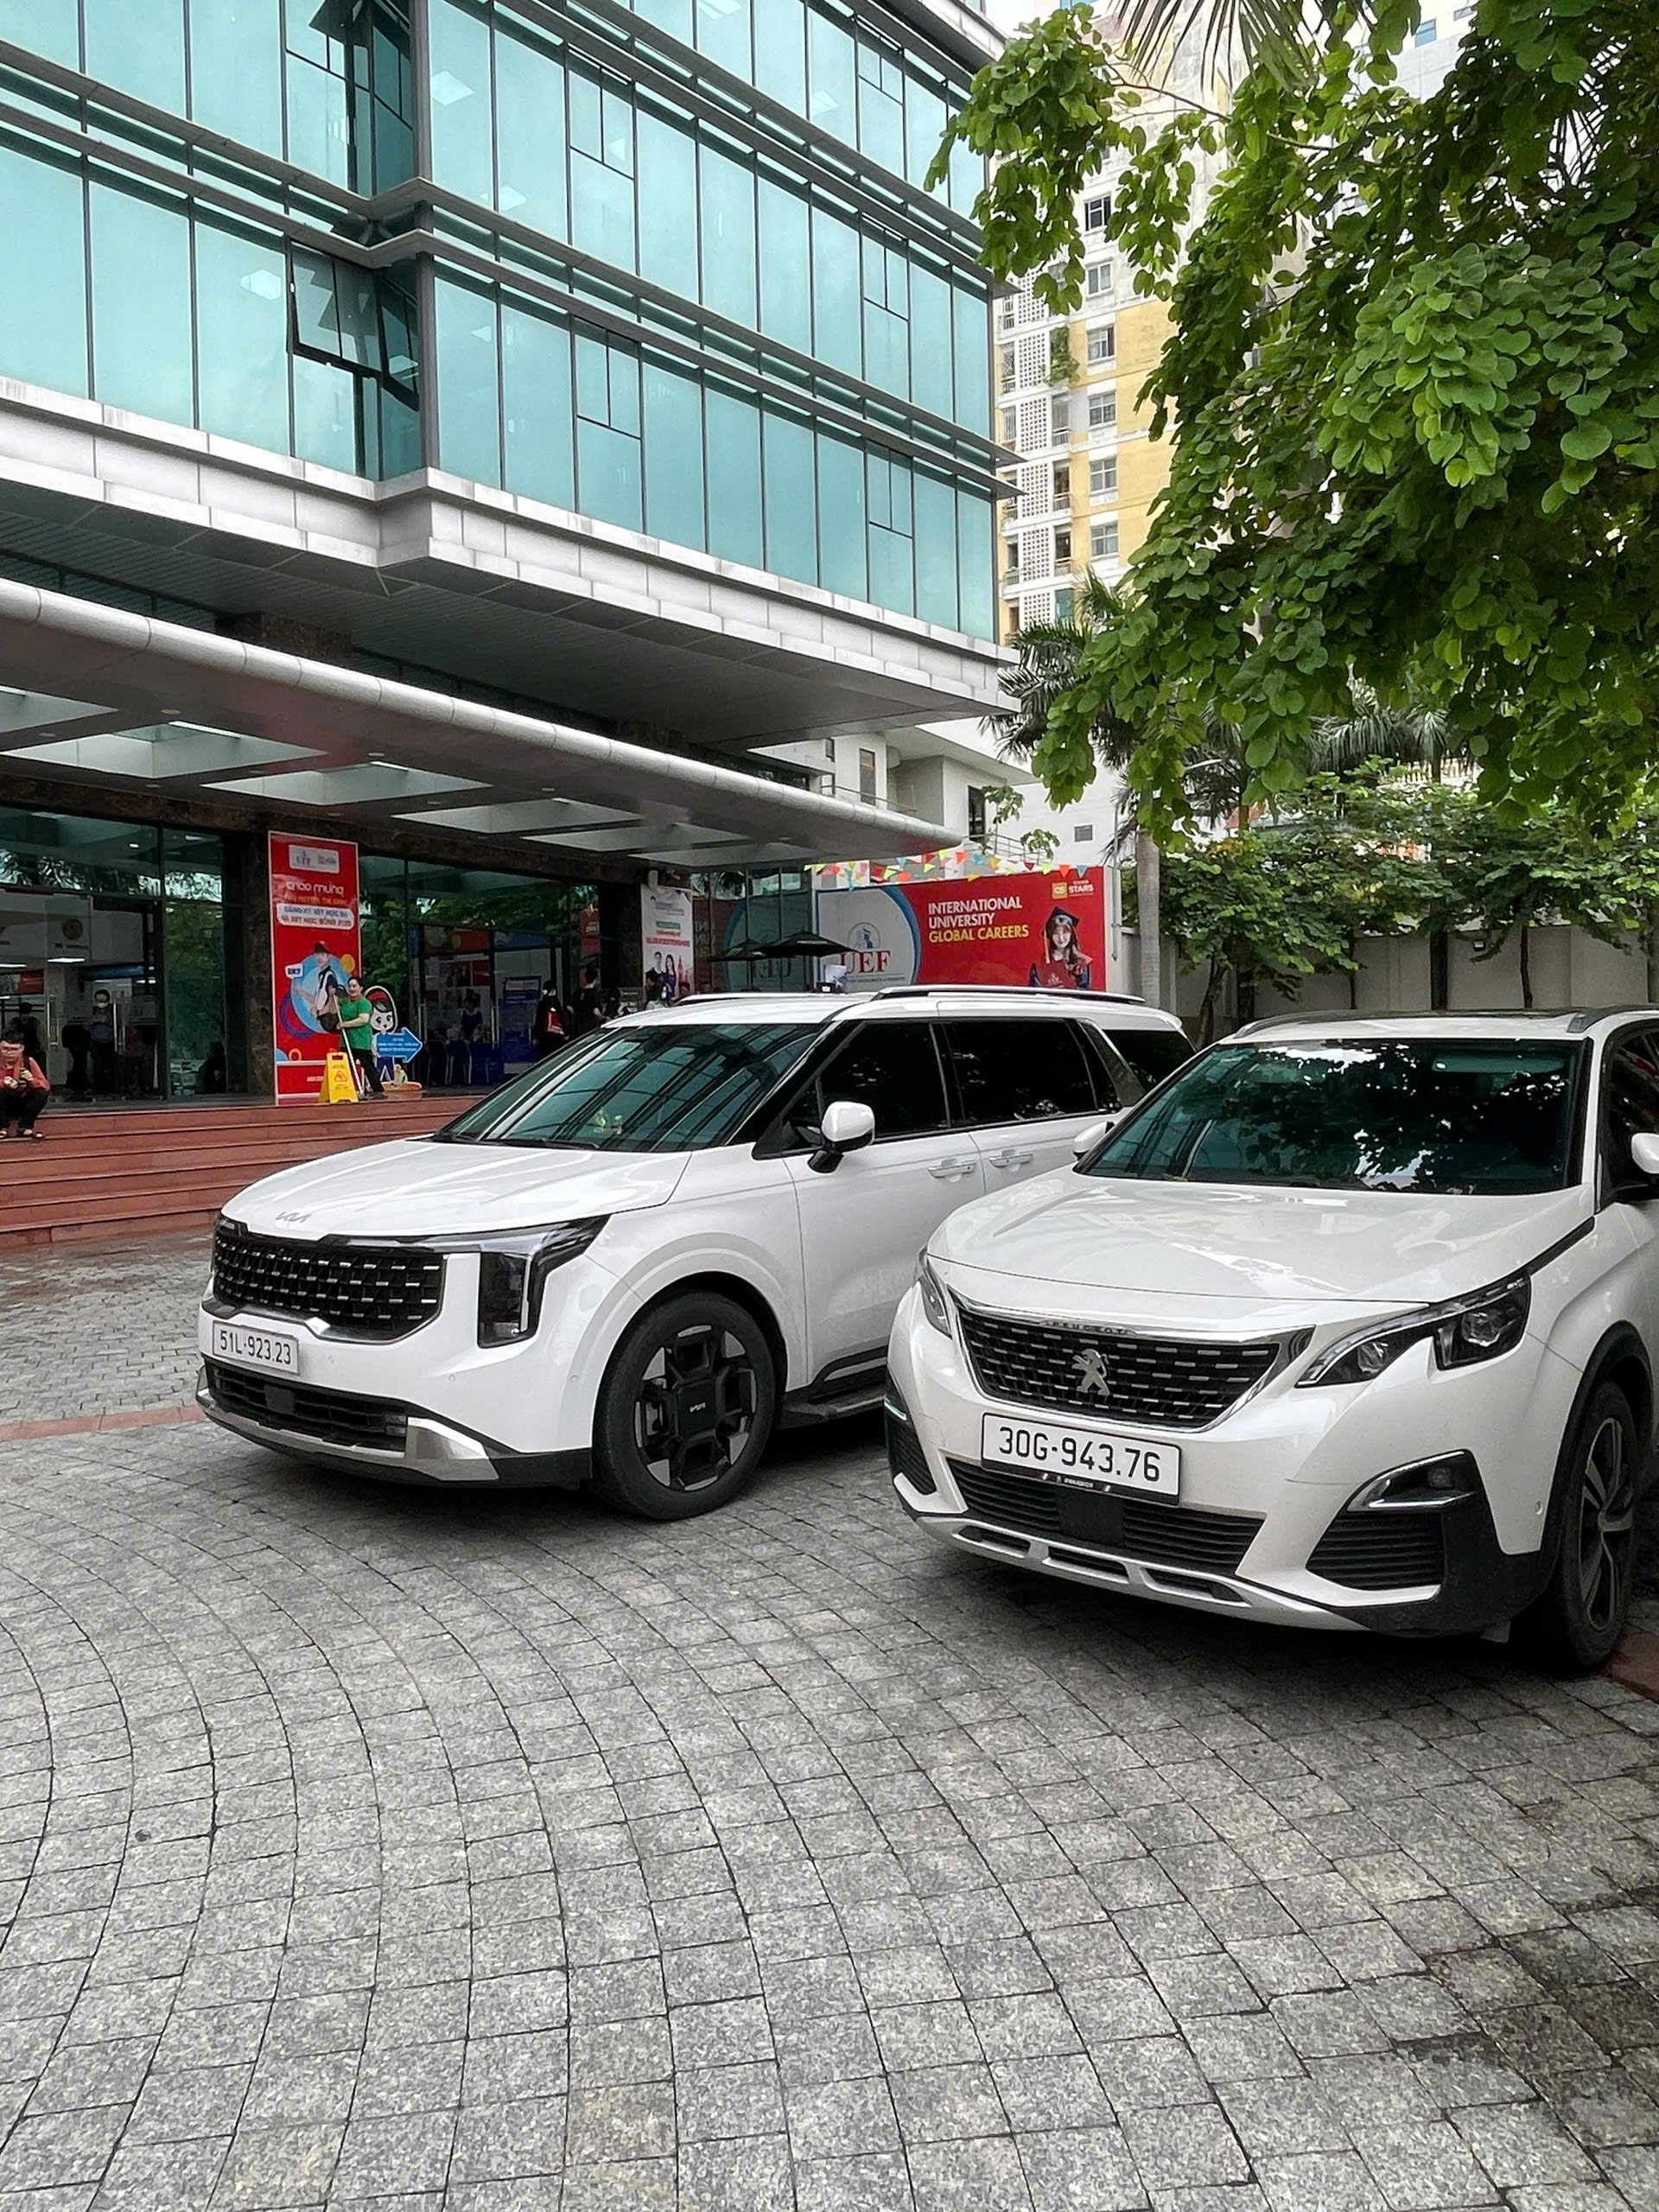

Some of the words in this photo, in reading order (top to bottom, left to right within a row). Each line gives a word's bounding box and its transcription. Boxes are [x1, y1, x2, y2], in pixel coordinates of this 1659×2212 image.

[1068, 884, 1094, 893] STARS
[928, 896, 1022, 915] INTERNATIONAL
[929, 912, 995, 929] UNIVERSITY
[929, 929, 975, 943] GLOBAL
[977, 925, 1029, 940] CAREERS
[219, 1328, 292, 1365] 51L-923.23
[998, 1426, 1161, 1483] 30G-943.76
